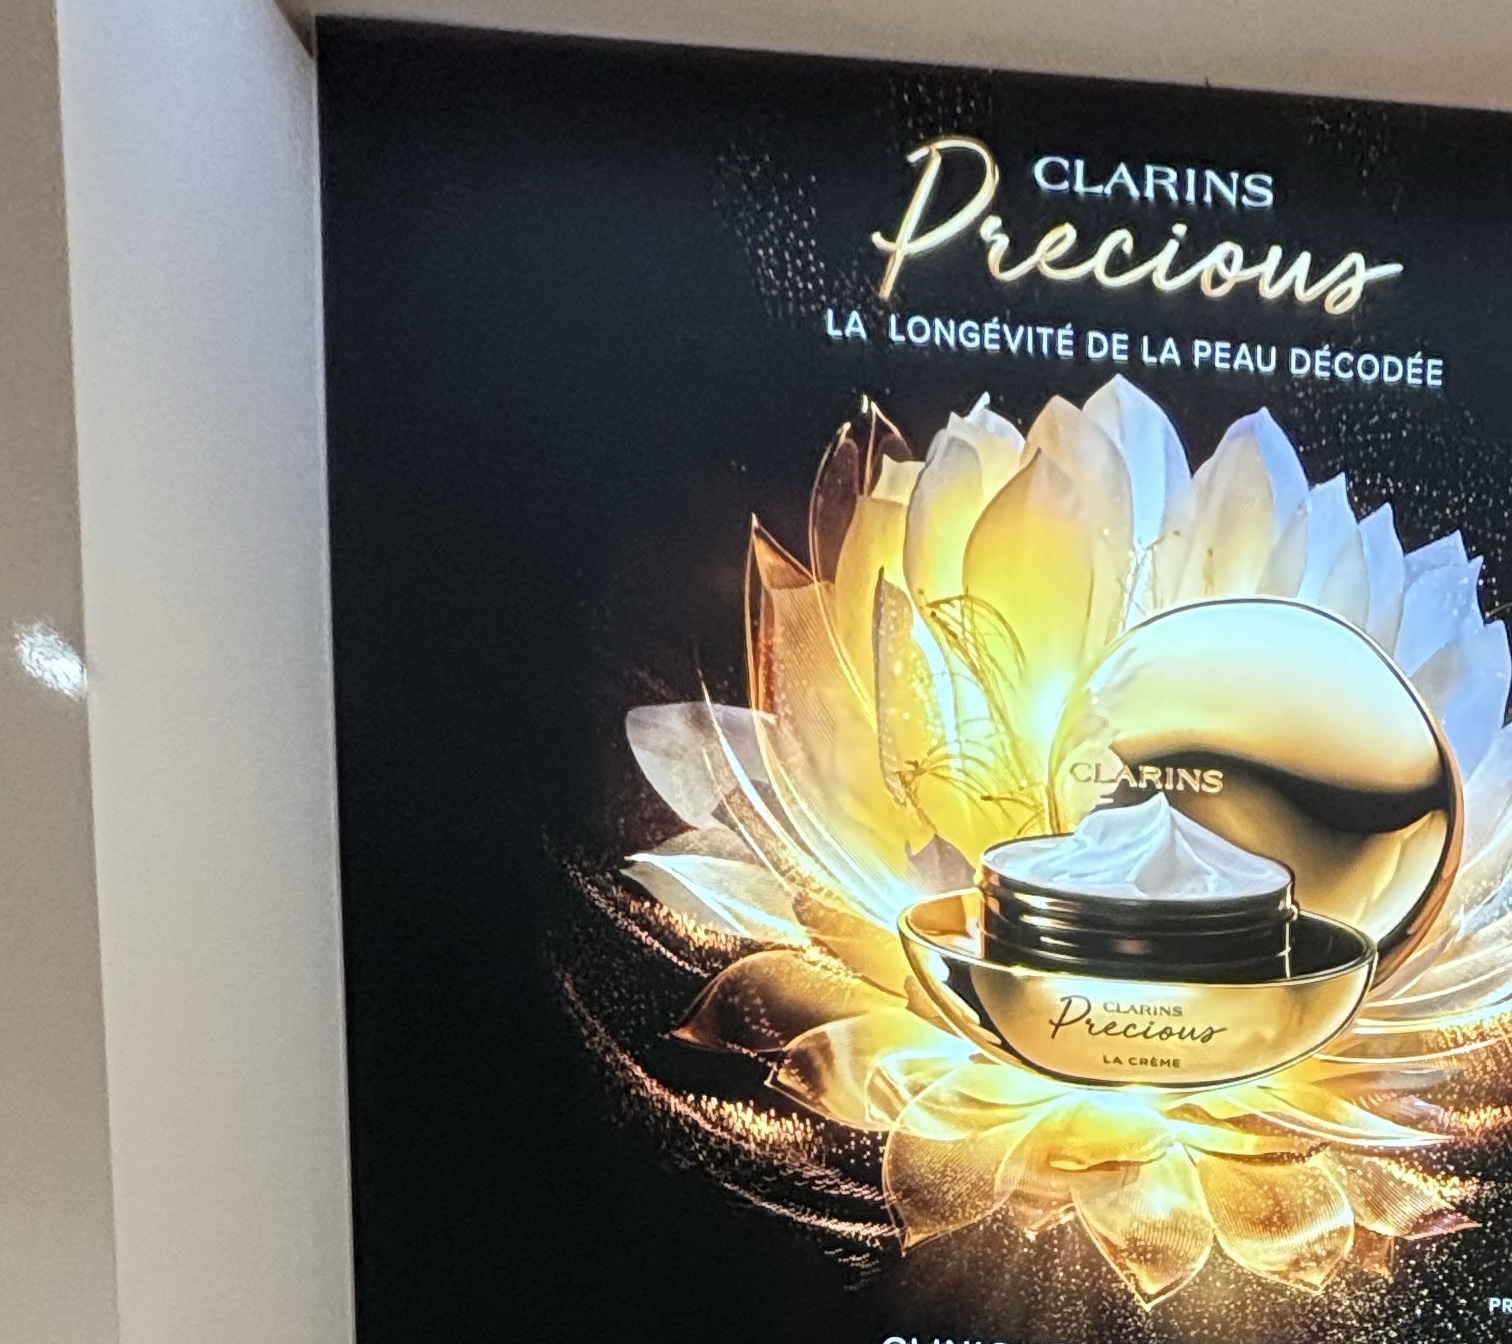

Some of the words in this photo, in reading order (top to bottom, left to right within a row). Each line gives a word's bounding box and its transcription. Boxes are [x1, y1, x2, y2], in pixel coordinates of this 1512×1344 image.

[1033, 155, 1275, 209] CLARINS
[871, 135, 1403, 315] Precious
[825, 308, 867, 338] LA
[889, 313, 1074, 358] LONGÉVITÉ
[1087, 331, 1129, 361] DE
[1142, 335, 1181, 367] LA
[1194, 340, 1277, 374] PEAU
[1289, 340, 1444, 387] DÉCODÉE
[1070, 762, 1224, 794] CLARINS
[1049, 995, 1227, 1043] Precious
[1102, 1001, 1183, 1018] CLARINS
[1102, 1055, 1124, 1066] LA
[1128, 1053, 1181, 1069] CRÈME
